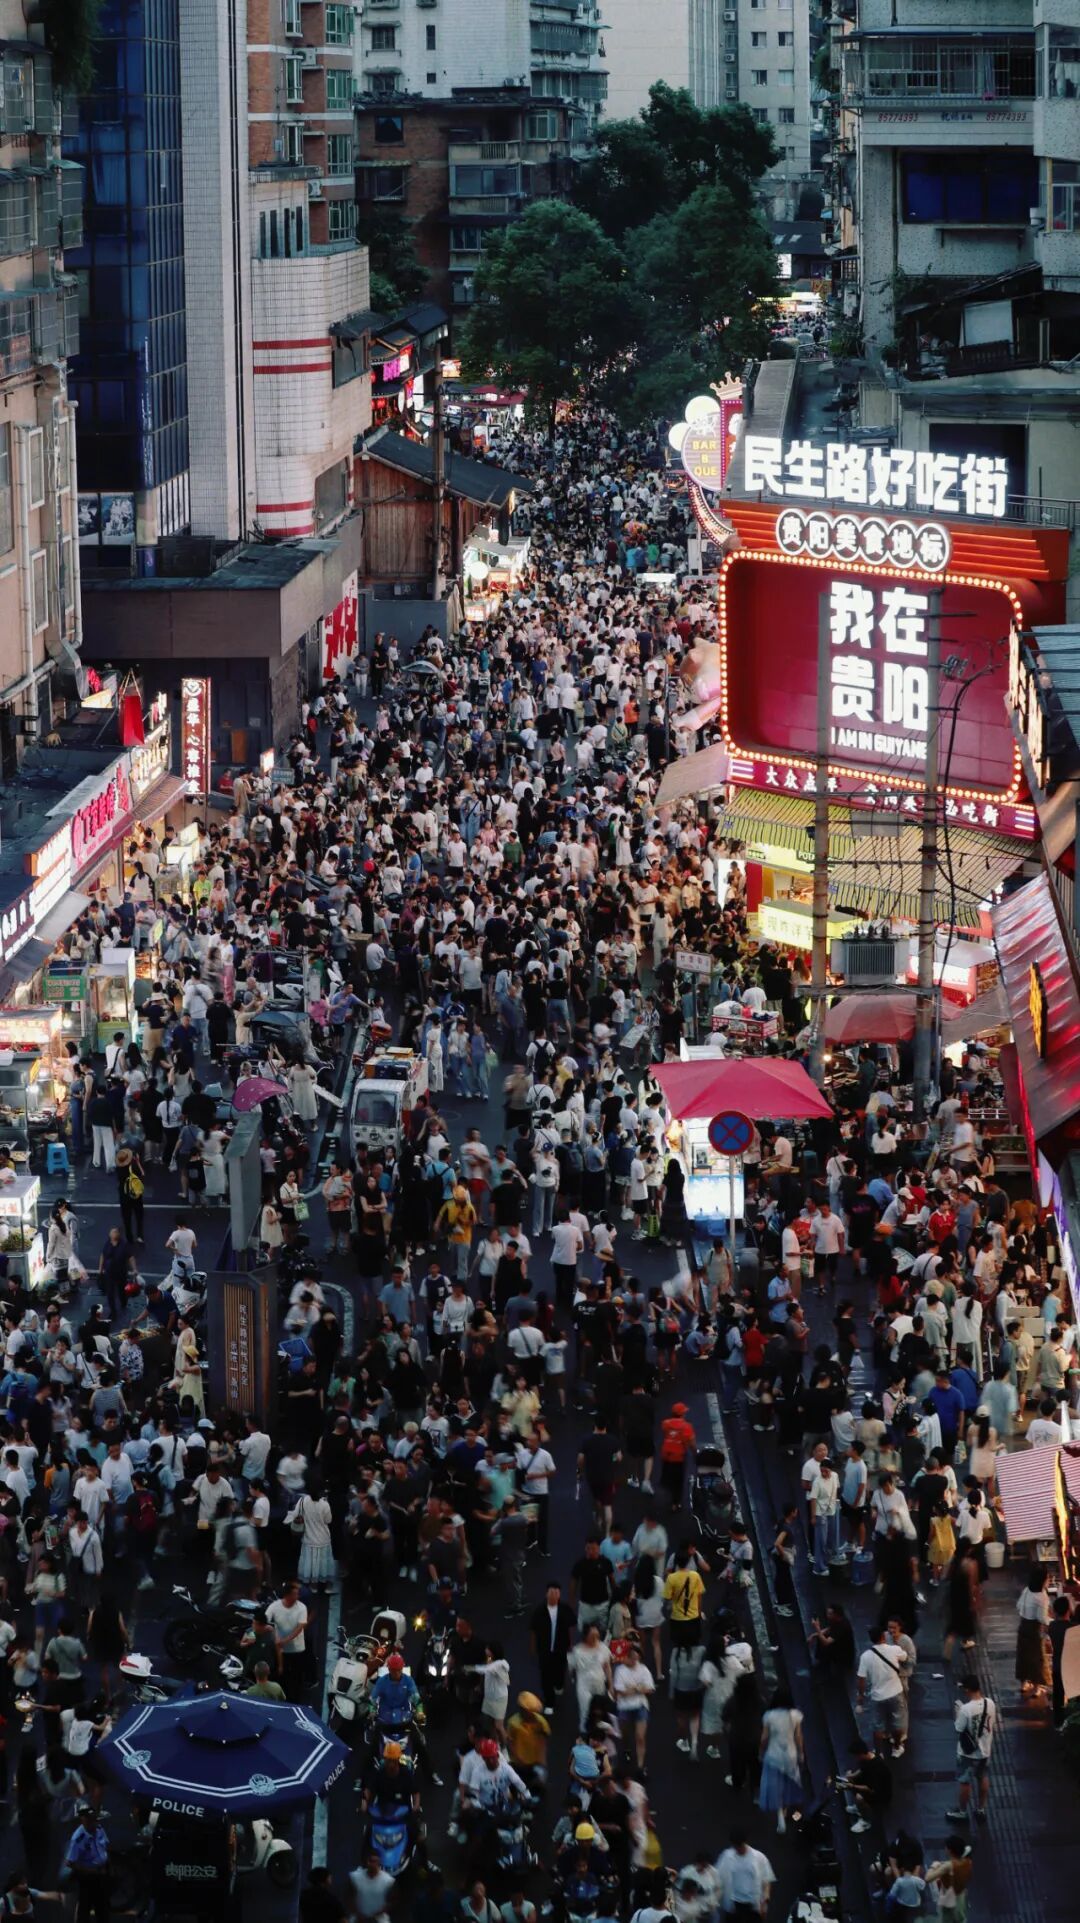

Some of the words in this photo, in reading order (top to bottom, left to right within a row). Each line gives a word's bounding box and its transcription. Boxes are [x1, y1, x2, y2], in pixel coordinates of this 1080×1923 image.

[692, 440, 717, 450] BAR
[693, 466, 717, 476] QUE
[701, 454, 708, 463] B
[744, 434, 1008, 517] 民生路好吃街
[782, 515, 944, 563] 贵阳美食地标
[829, 581, 929, 656] 我在
[830, 655, 929, 732] 贵阳
[831, 726, 836, 745] I
[838, 728, 857, 749] AM
[859, 731, 873, 751] IN
[324, 1759, 346, 1791] POLICE
[153, 1797, 205, 1818] POLICE
[164, 1861, 218, 1881] 贵阳公安
